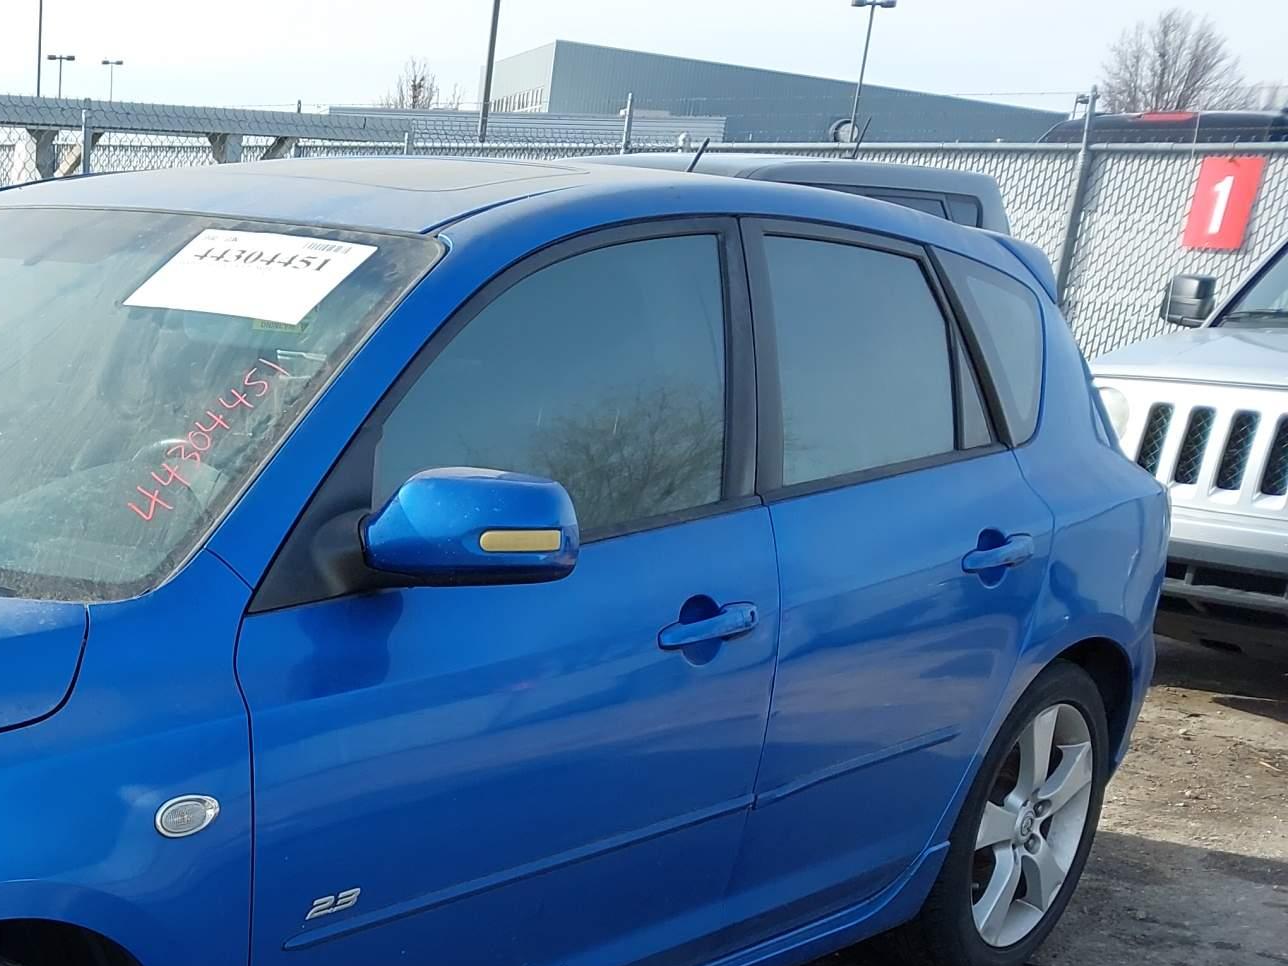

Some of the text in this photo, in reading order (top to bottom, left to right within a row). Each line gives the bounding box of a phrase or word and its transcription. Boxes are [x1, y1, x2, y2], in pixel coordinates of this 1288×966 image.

[1205, 175, 1235, 234] 1
[194, 248, 331, 271] 44304451
[127, 358, 291, 520] 44304451
